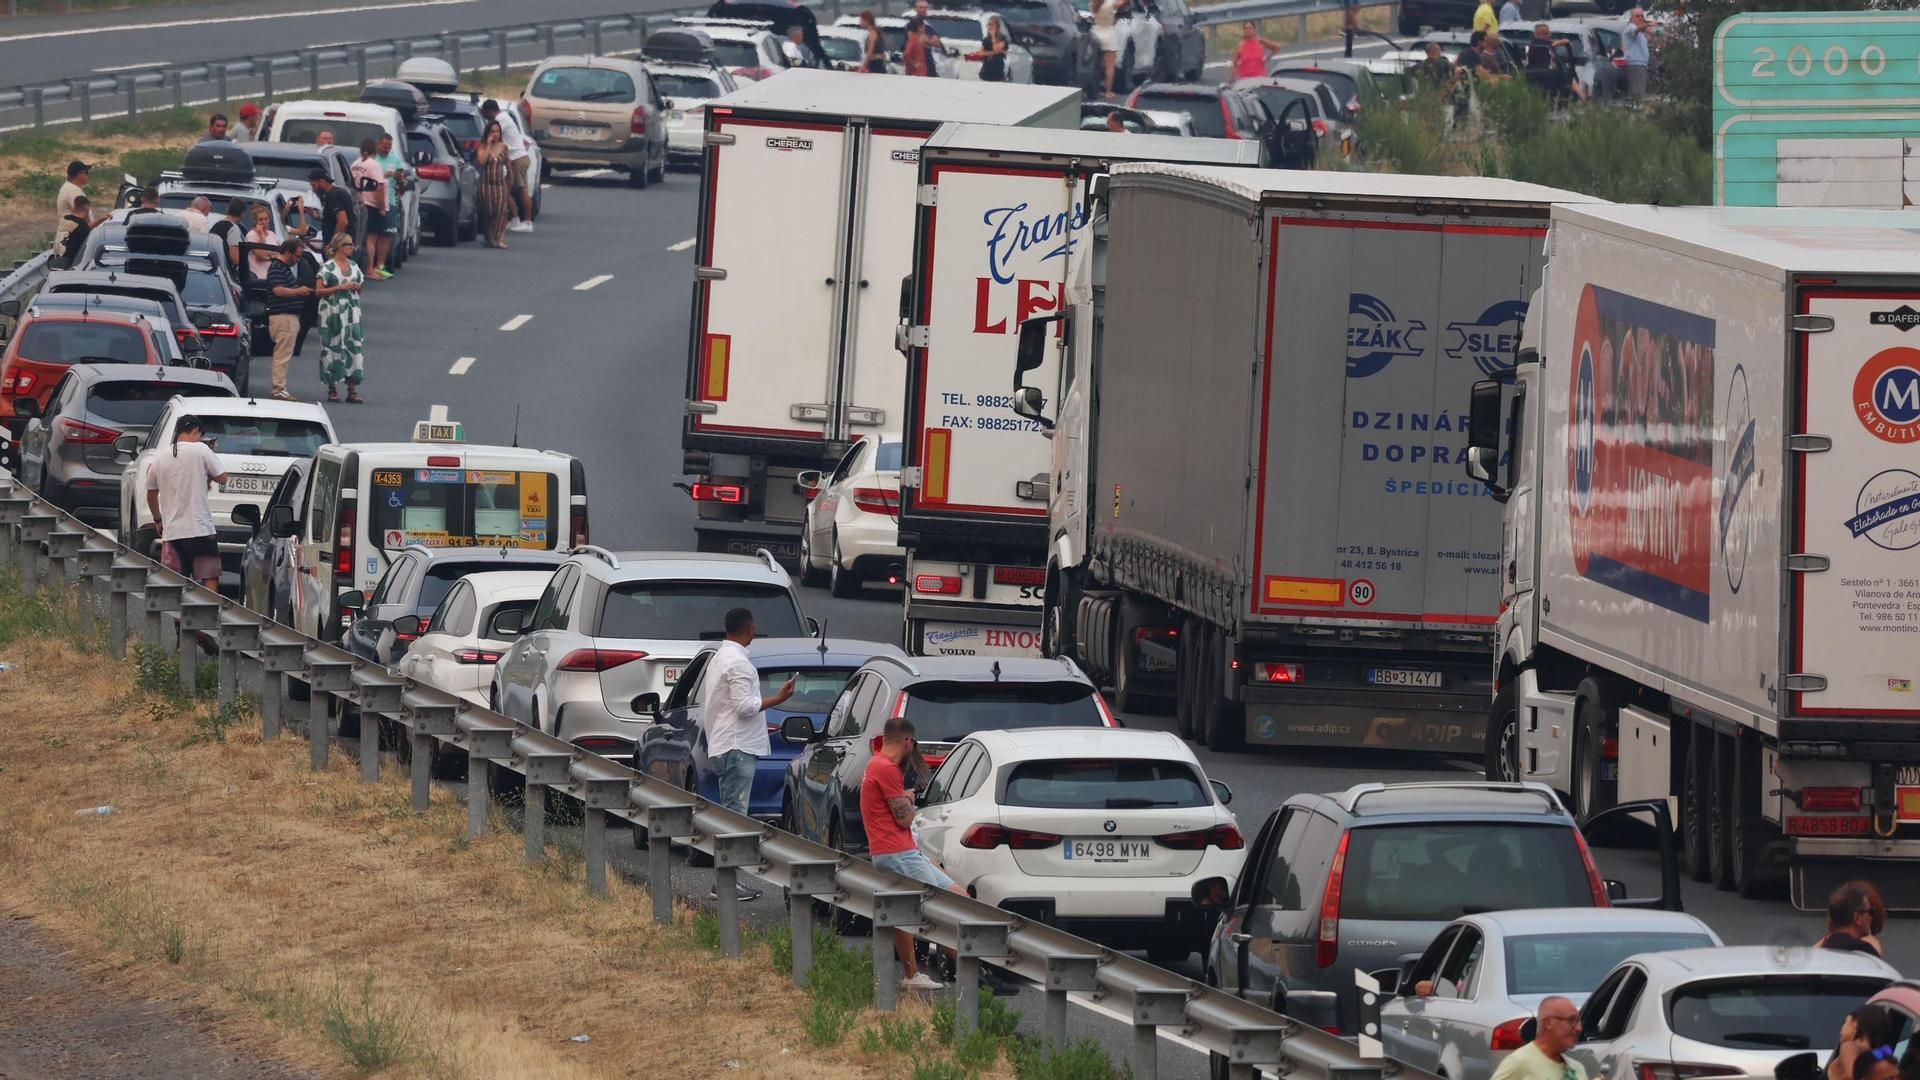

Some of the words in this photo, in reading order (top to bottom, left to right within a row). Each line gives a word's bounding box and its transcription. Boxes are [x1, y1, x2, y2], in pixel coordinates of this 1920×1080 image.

[1752, 44, 1887, 78] 2000
[767, 138, 812, 149] CHEREAU
[942, 393, 970, 405] TEL.
[942, 416, 972, 428] FAX:
[432, 426, 453, 438] TAXI
[229, 478, 258, 489] 4666
[261, 479, 277, 490] MX
[375, 473, 401, 484] X-4353
[1854, 505, 1898, 532] Elaborado
[1899, 503, 1909, 512] en
[1349, 545, 1364, 556] 23,
[1367, 546, 1377, 555] B.
[1379, 546, 1419, 559] Bystrica
[1437, 551, 1470, 560] e-mail:
[1341, 559, 1352, 568] 48
[1355, 560, 1373, 569] 412
[1376, 561, 1387, 570] 56
[1391, 562, 1402, 571] 18
[1840, 577, 1872, 587] Sestelo
[1355, 585, 1370, 599] 90
[1855, 589, 1891, 599] Vilanova
[1893, 590, 1904, 599] de
[1852, 600, 1901, 610] Pontevedra
[1859, 611, 1873, 621] Tel.
[1876, 612, 1893, 621] 986
[1895, 612, 1906, 621] 50
[939, 648, 976, 656] VOLVO
[1287, 723, 1350, 736] www.adip.cz
[1075, 842, 1115, 857] 6498
[1120, 844, 1150, 858] MYM
